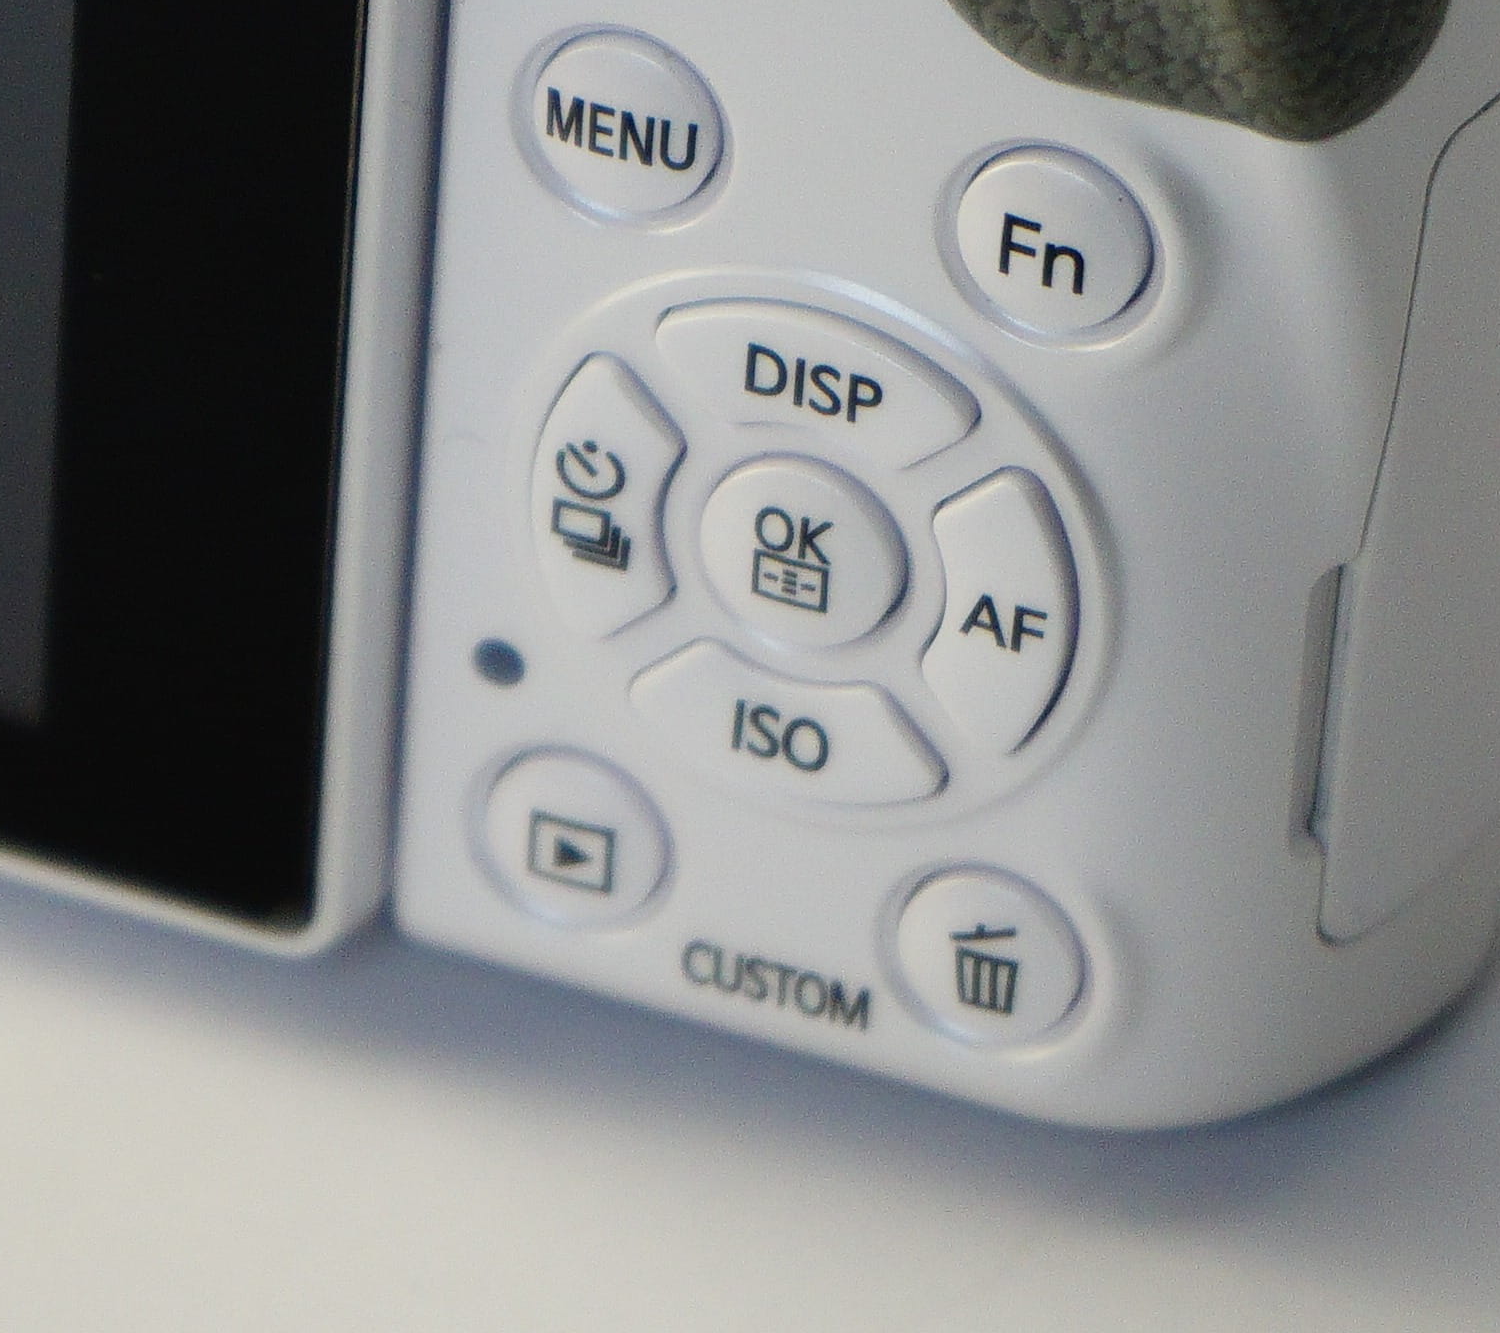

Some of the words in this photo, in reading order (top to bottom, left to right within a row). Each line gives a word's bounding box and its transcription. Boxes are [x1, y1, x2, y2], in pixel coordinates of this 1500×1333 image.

[545, 87, 699, 173] MENU
[997, 212, 1086, 296] Fn
[744, 342, 884, 424] DISP
[754, 505, 835, 566] OK
[959, 593, 1048, 653] AF
[730, 698, 830, 773] ISO
[680, 939, 872, 1032] CUSTOM
